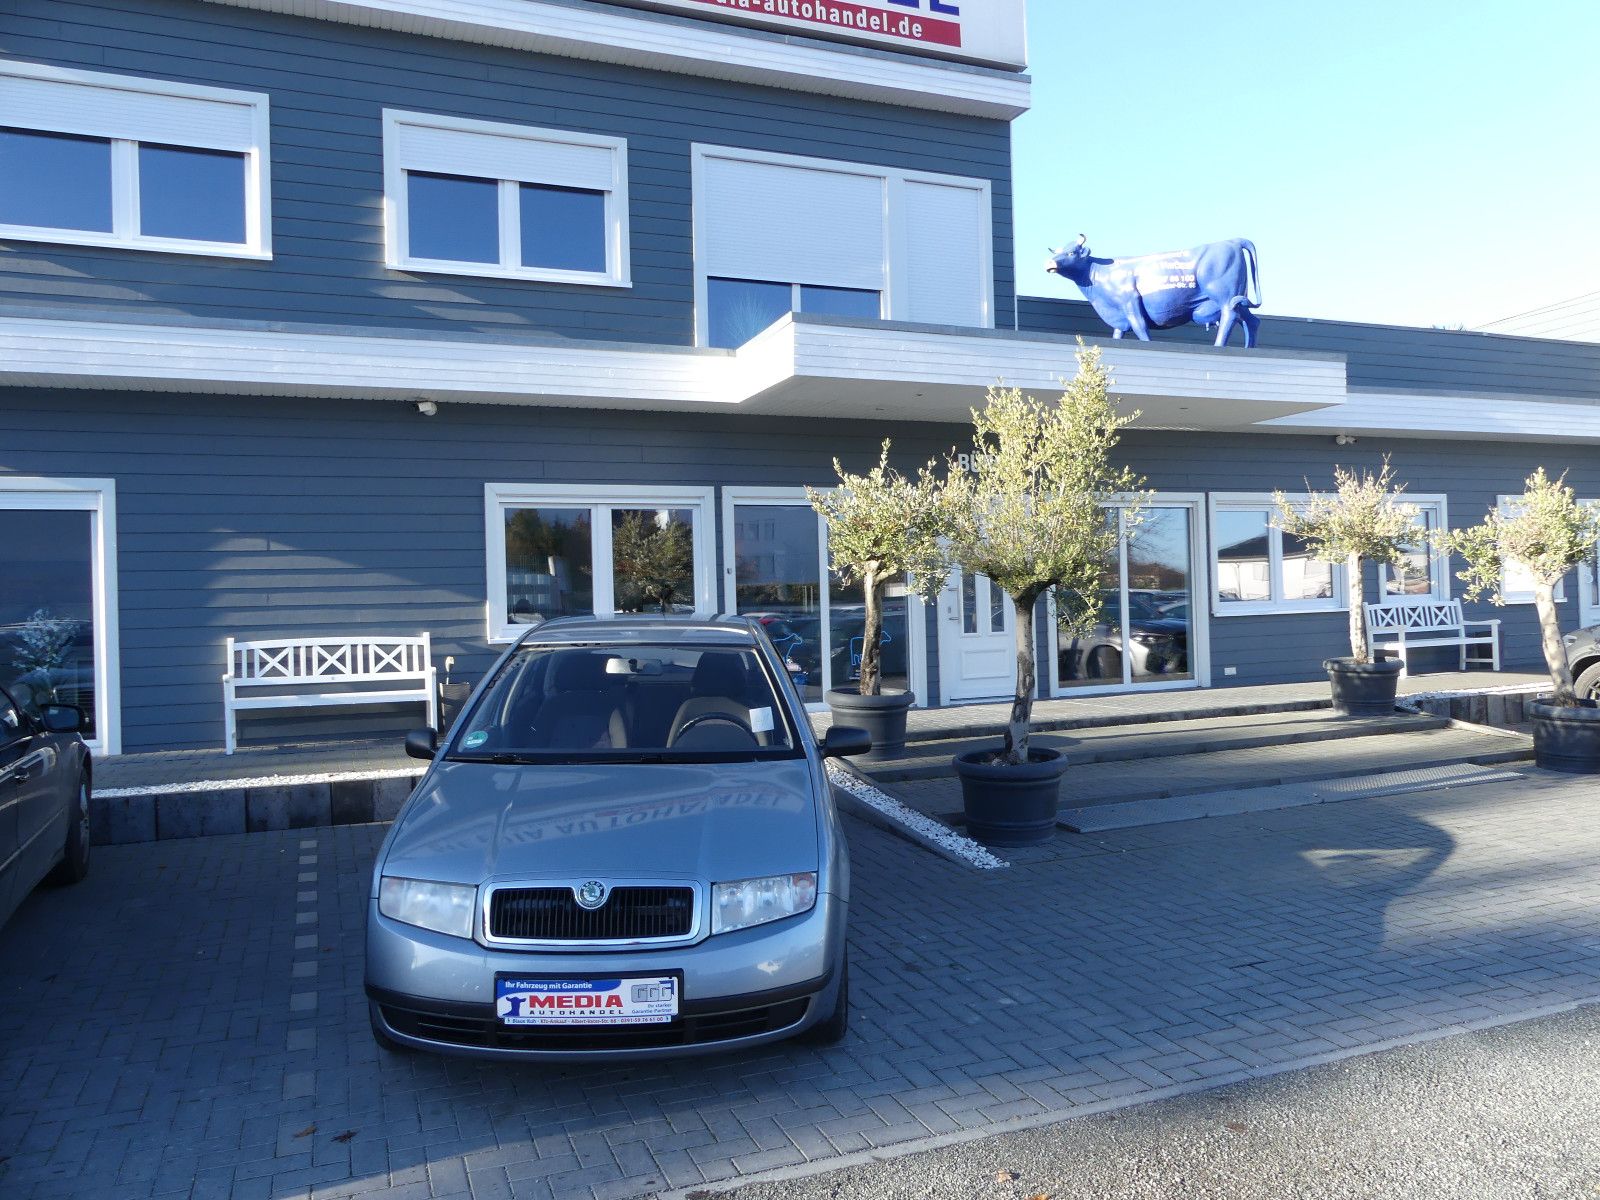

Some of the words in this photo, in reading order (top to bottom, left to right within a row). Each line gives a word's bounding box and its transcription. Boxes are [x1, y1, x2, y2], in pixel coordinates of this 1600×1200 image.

[716, 0, 923, 38] a-autohandel.de
[505, 981, 515, 989] Ihr
[516, 982, 548, 990] Fahrzeug
[529, 995, 624, 1008] MEDIA
